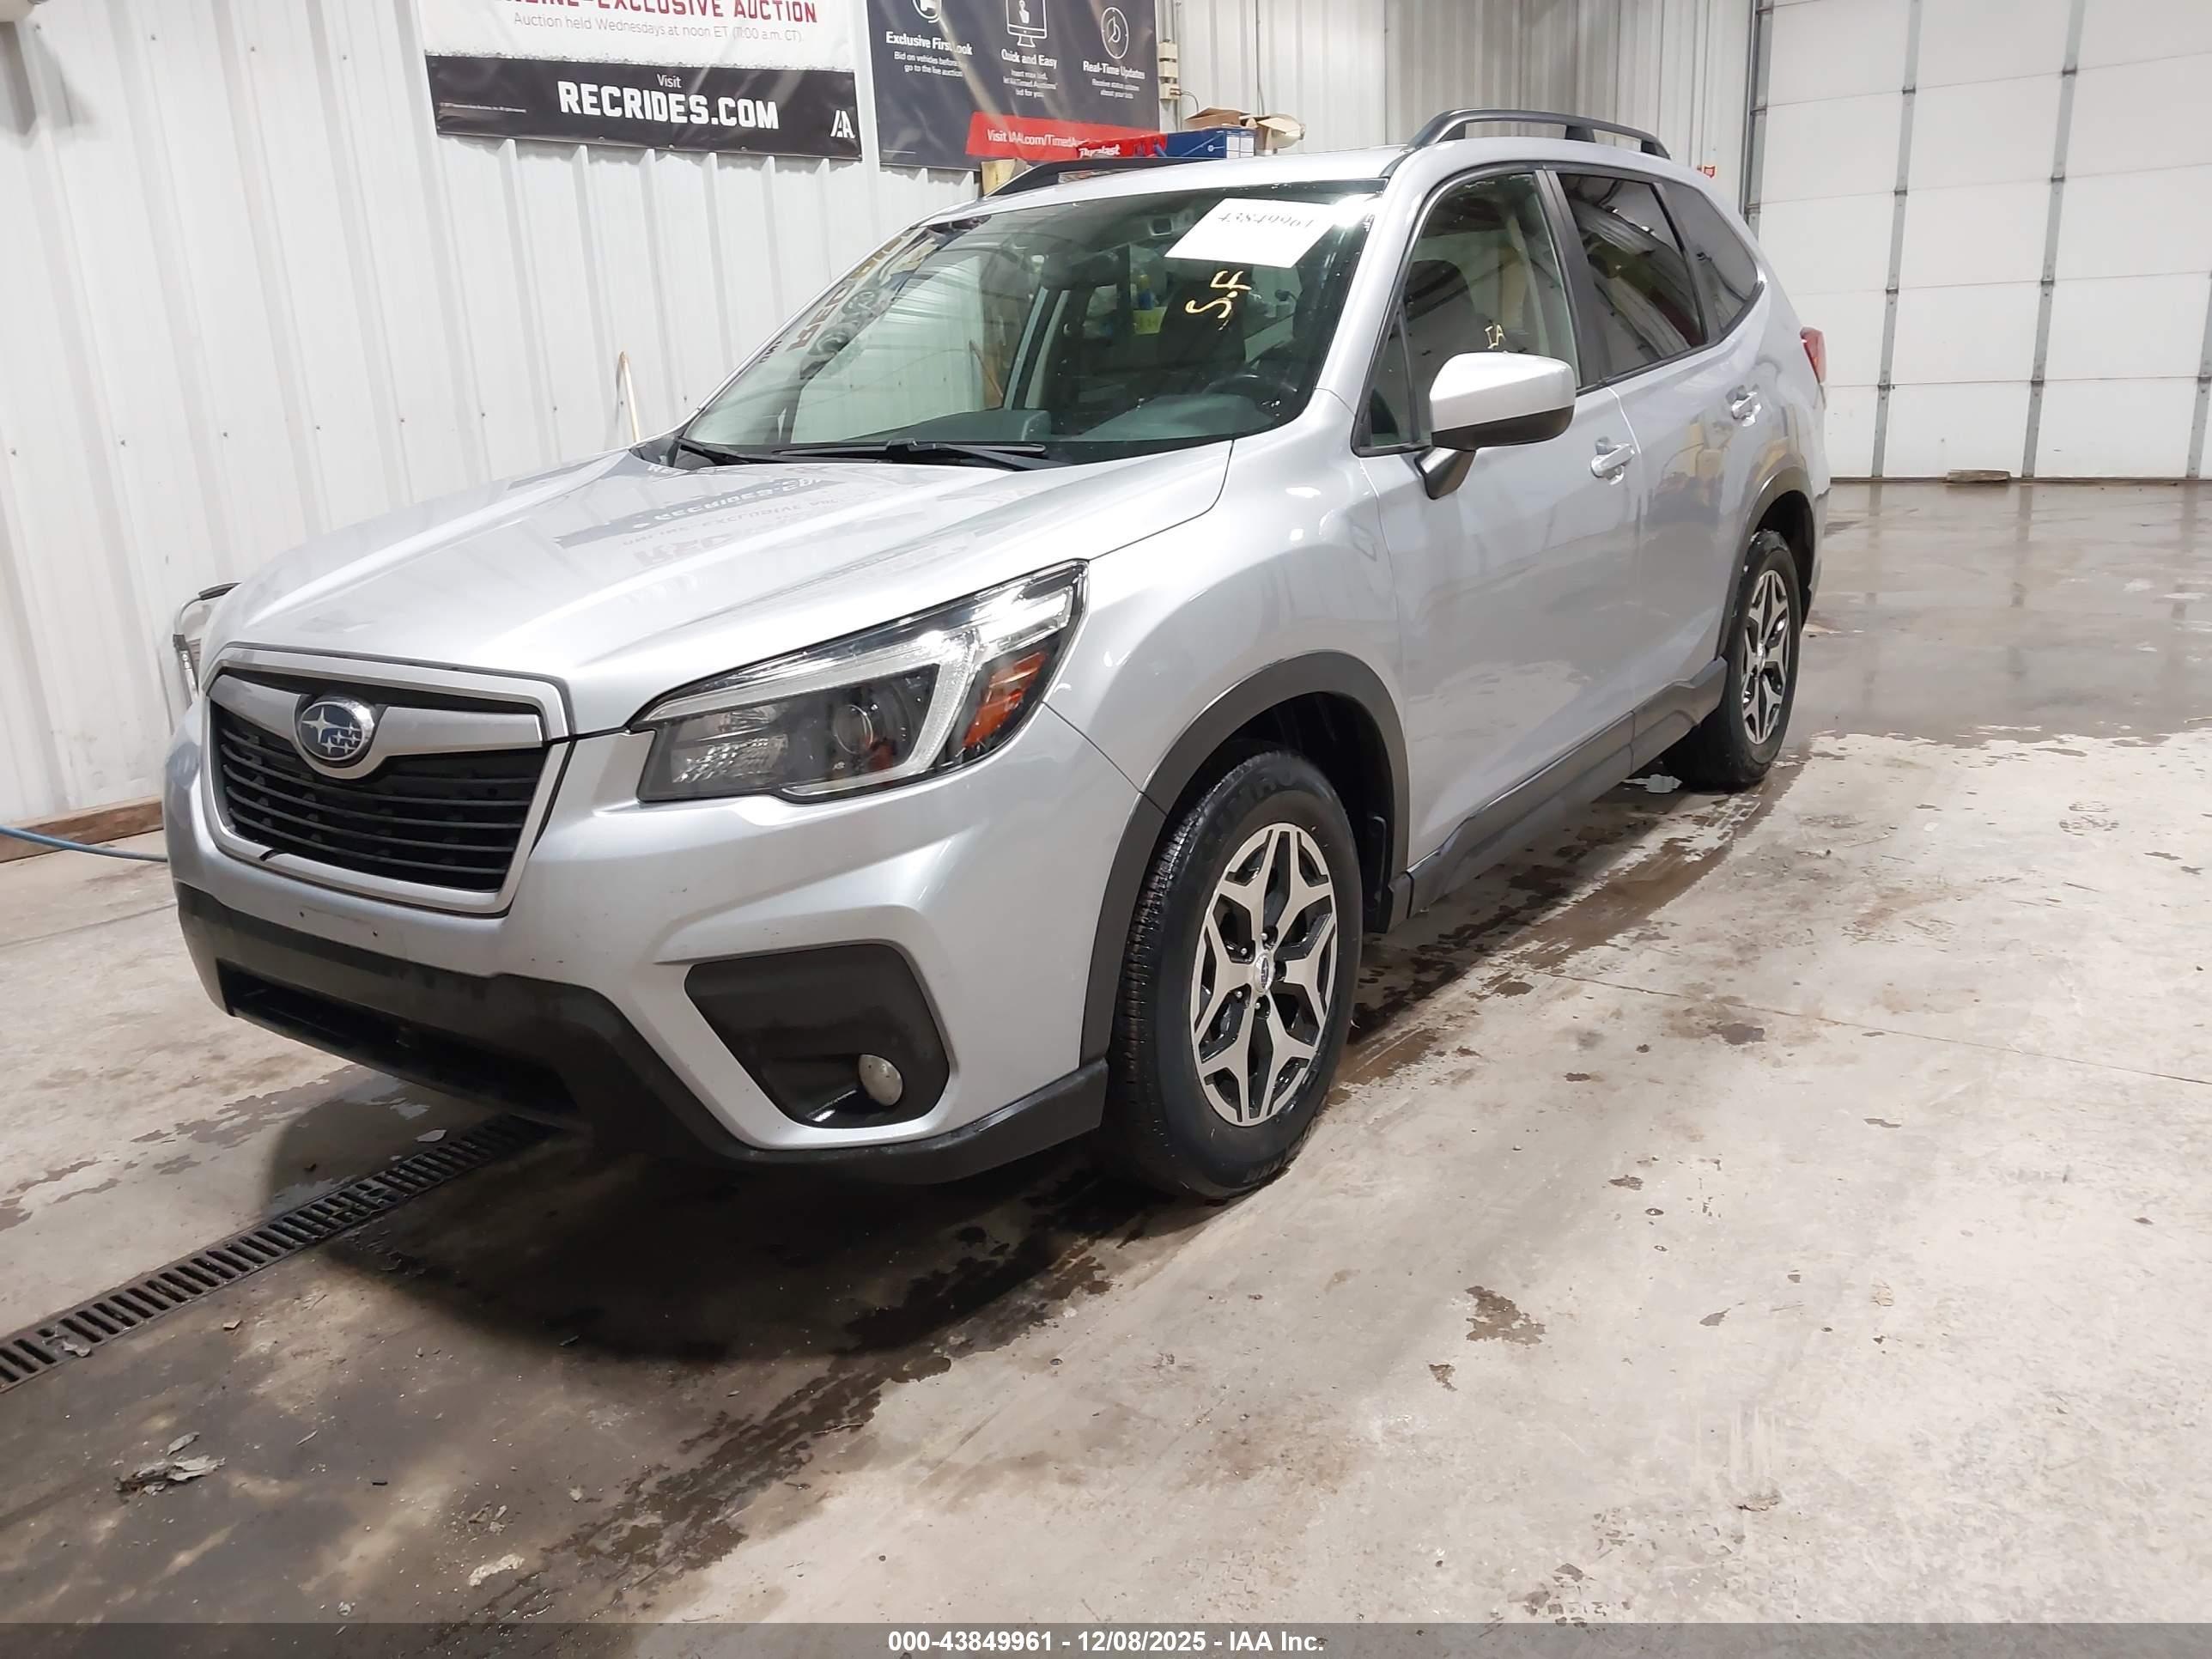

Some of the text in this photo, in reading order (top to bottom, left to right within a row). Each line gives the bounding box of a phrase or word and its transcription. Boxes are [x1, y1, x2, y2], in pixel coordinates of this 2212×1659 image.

[734, 0, 817, 23] AUCTION
[514, 12, 562, 28] Auction
[567, 15, 592, 30] held
[595, 18, 665, 36] Wednesdays
[668, 26, 679, 36] at
[683, 27, 711, 37] noon
[714, 26, 728, 38] ET
[885, 31, 932, 48] Exclusive
[1001, 48, 1058, 70] Quick and Easy
[1083, 60, 1120, 76] Real-Time
[656, 73, 682, 88] Visit
[557, 80, 780, 130] RECRIDES.COM
[988, 129, 1007, 143] Visit
